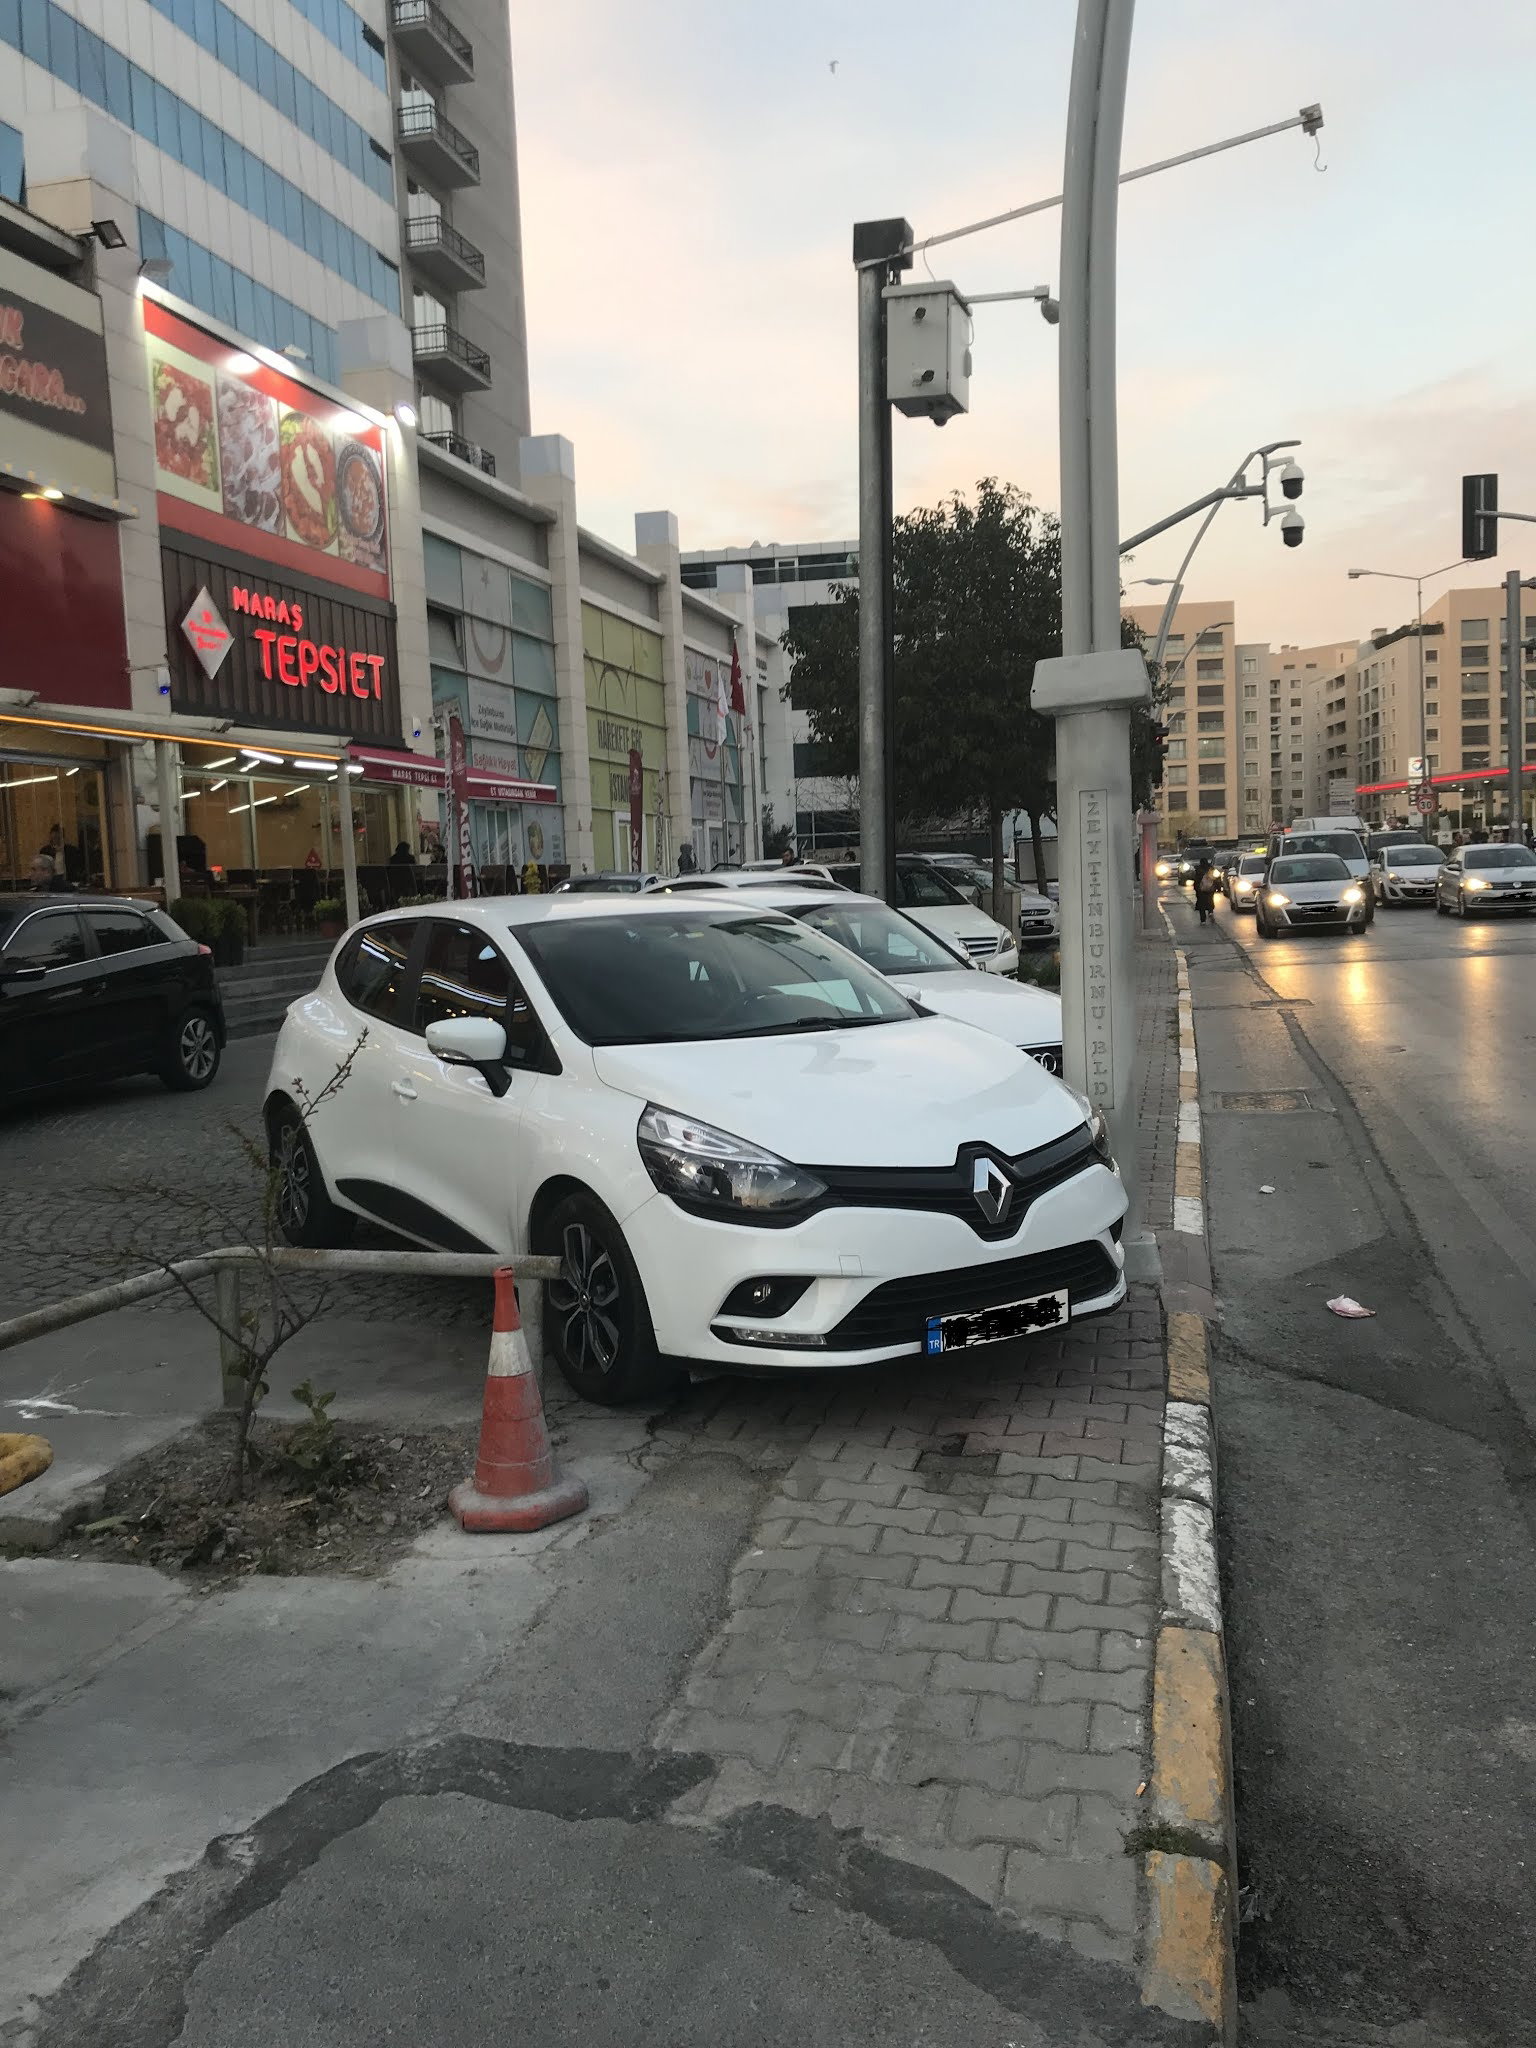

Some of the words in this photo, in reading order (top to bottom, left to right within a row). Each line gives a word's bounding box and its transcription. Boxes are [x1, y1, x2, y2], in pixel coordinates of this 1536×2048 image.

[232, 585, 304, 632] MARAŞ
[597, 719, 630, 753] HAREKETE
[391, 768, 412, 781] MARAŞ
[1420, 801, 1432, 810] 30
[929, 1339, 940, 1350] TR
